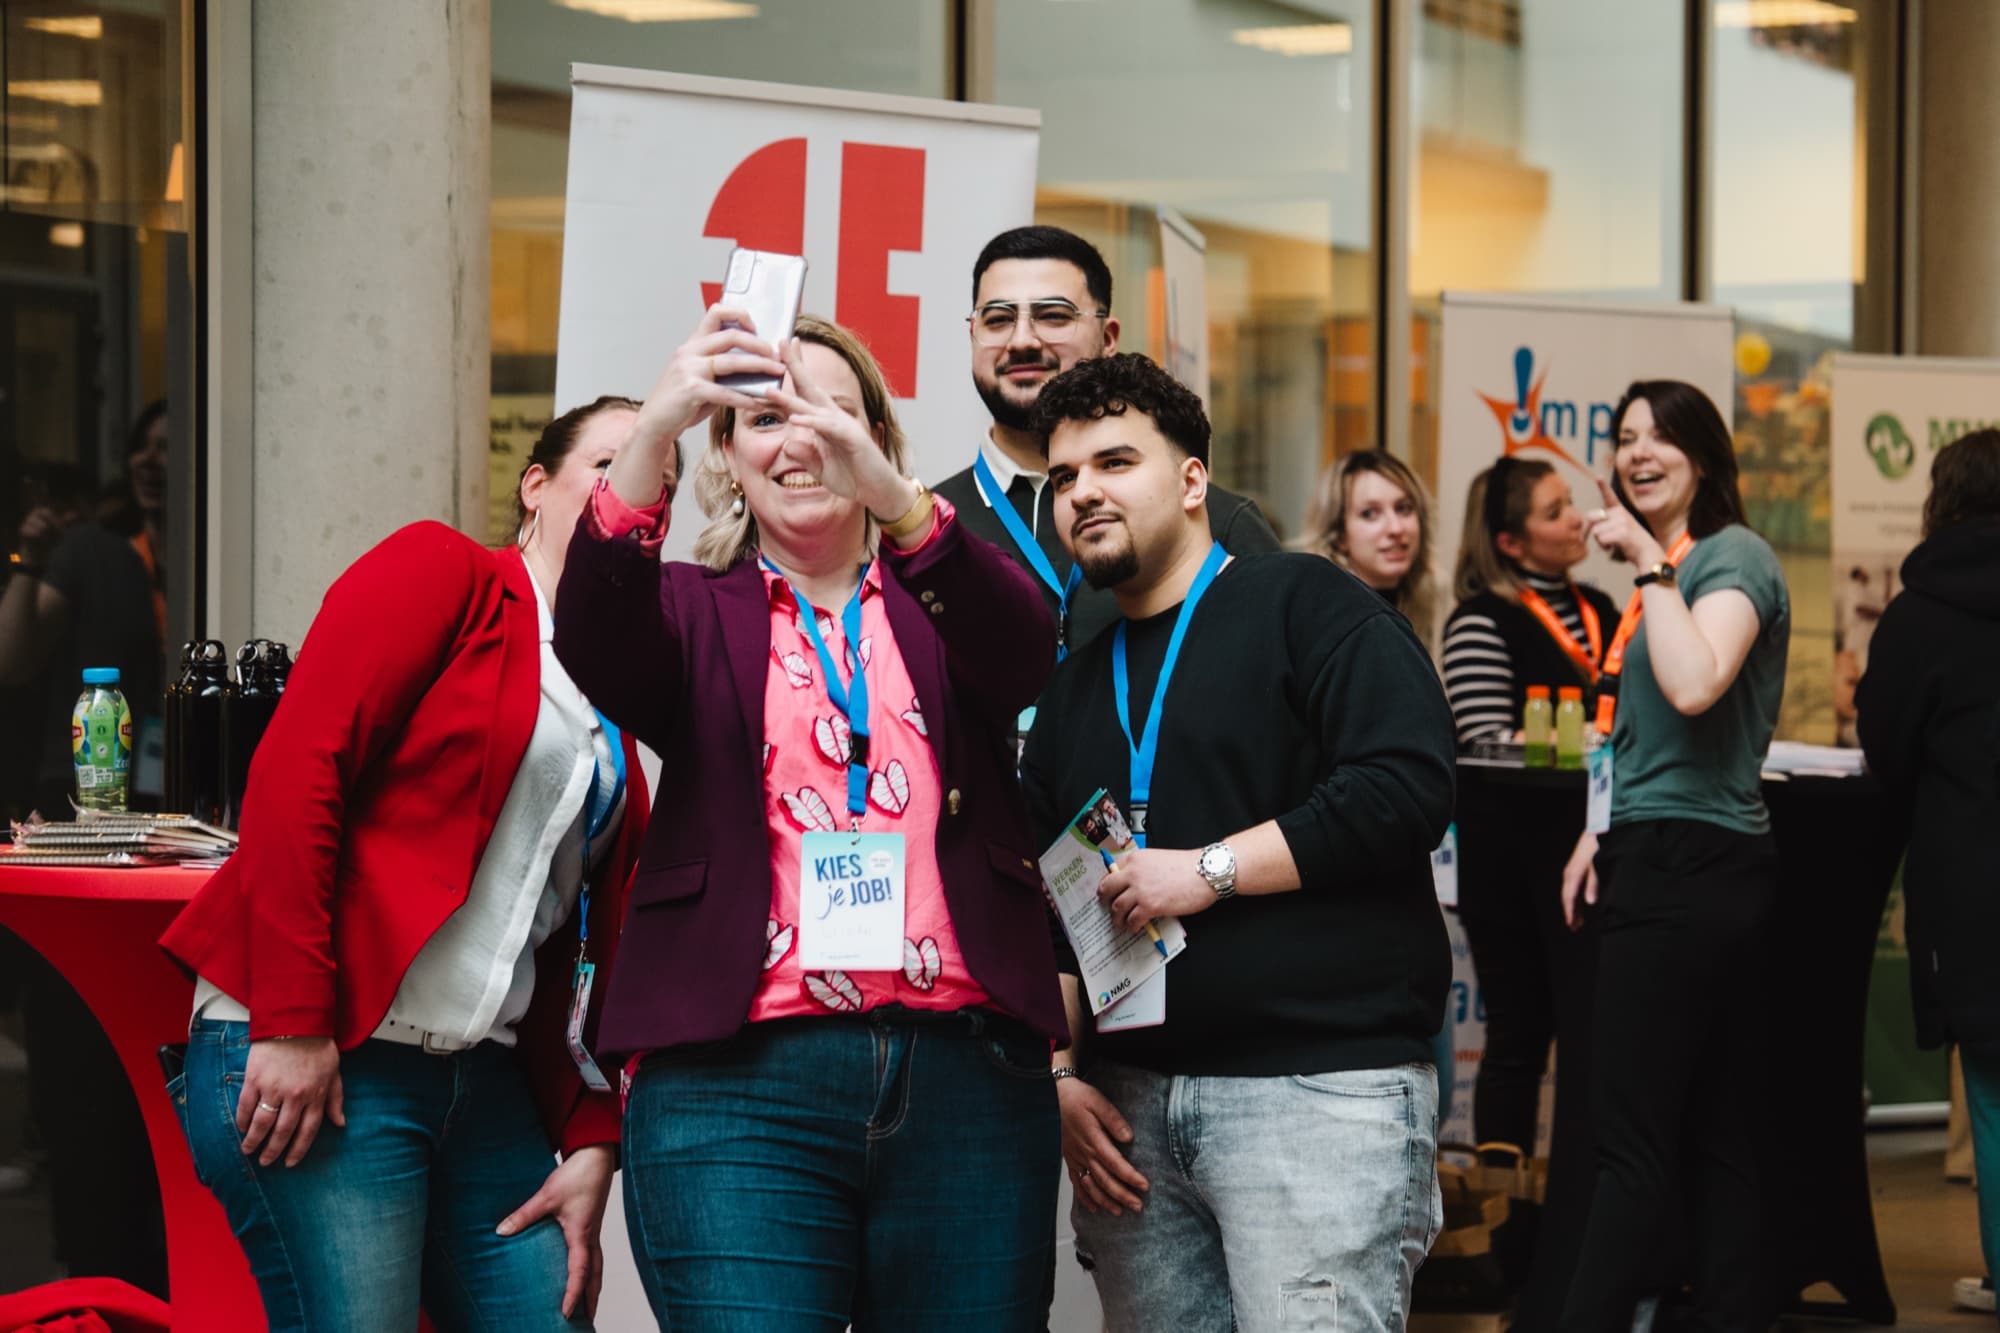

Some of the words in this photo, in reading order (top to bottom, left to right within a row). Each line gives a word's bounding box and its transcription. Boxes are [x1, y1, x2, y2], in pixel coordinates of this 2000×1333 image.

[815, 853, 862, 882] KIES
[1052, 855, 1083, 887] WERKEN
[1056, 881, 1070, 897] BIJ
[1069, 864, 1088, 885] NMG
[815, 884, 845, 920] je
[850, 877, 893, 906] JOB!
[1109, 978, 1132, 998] NMG
